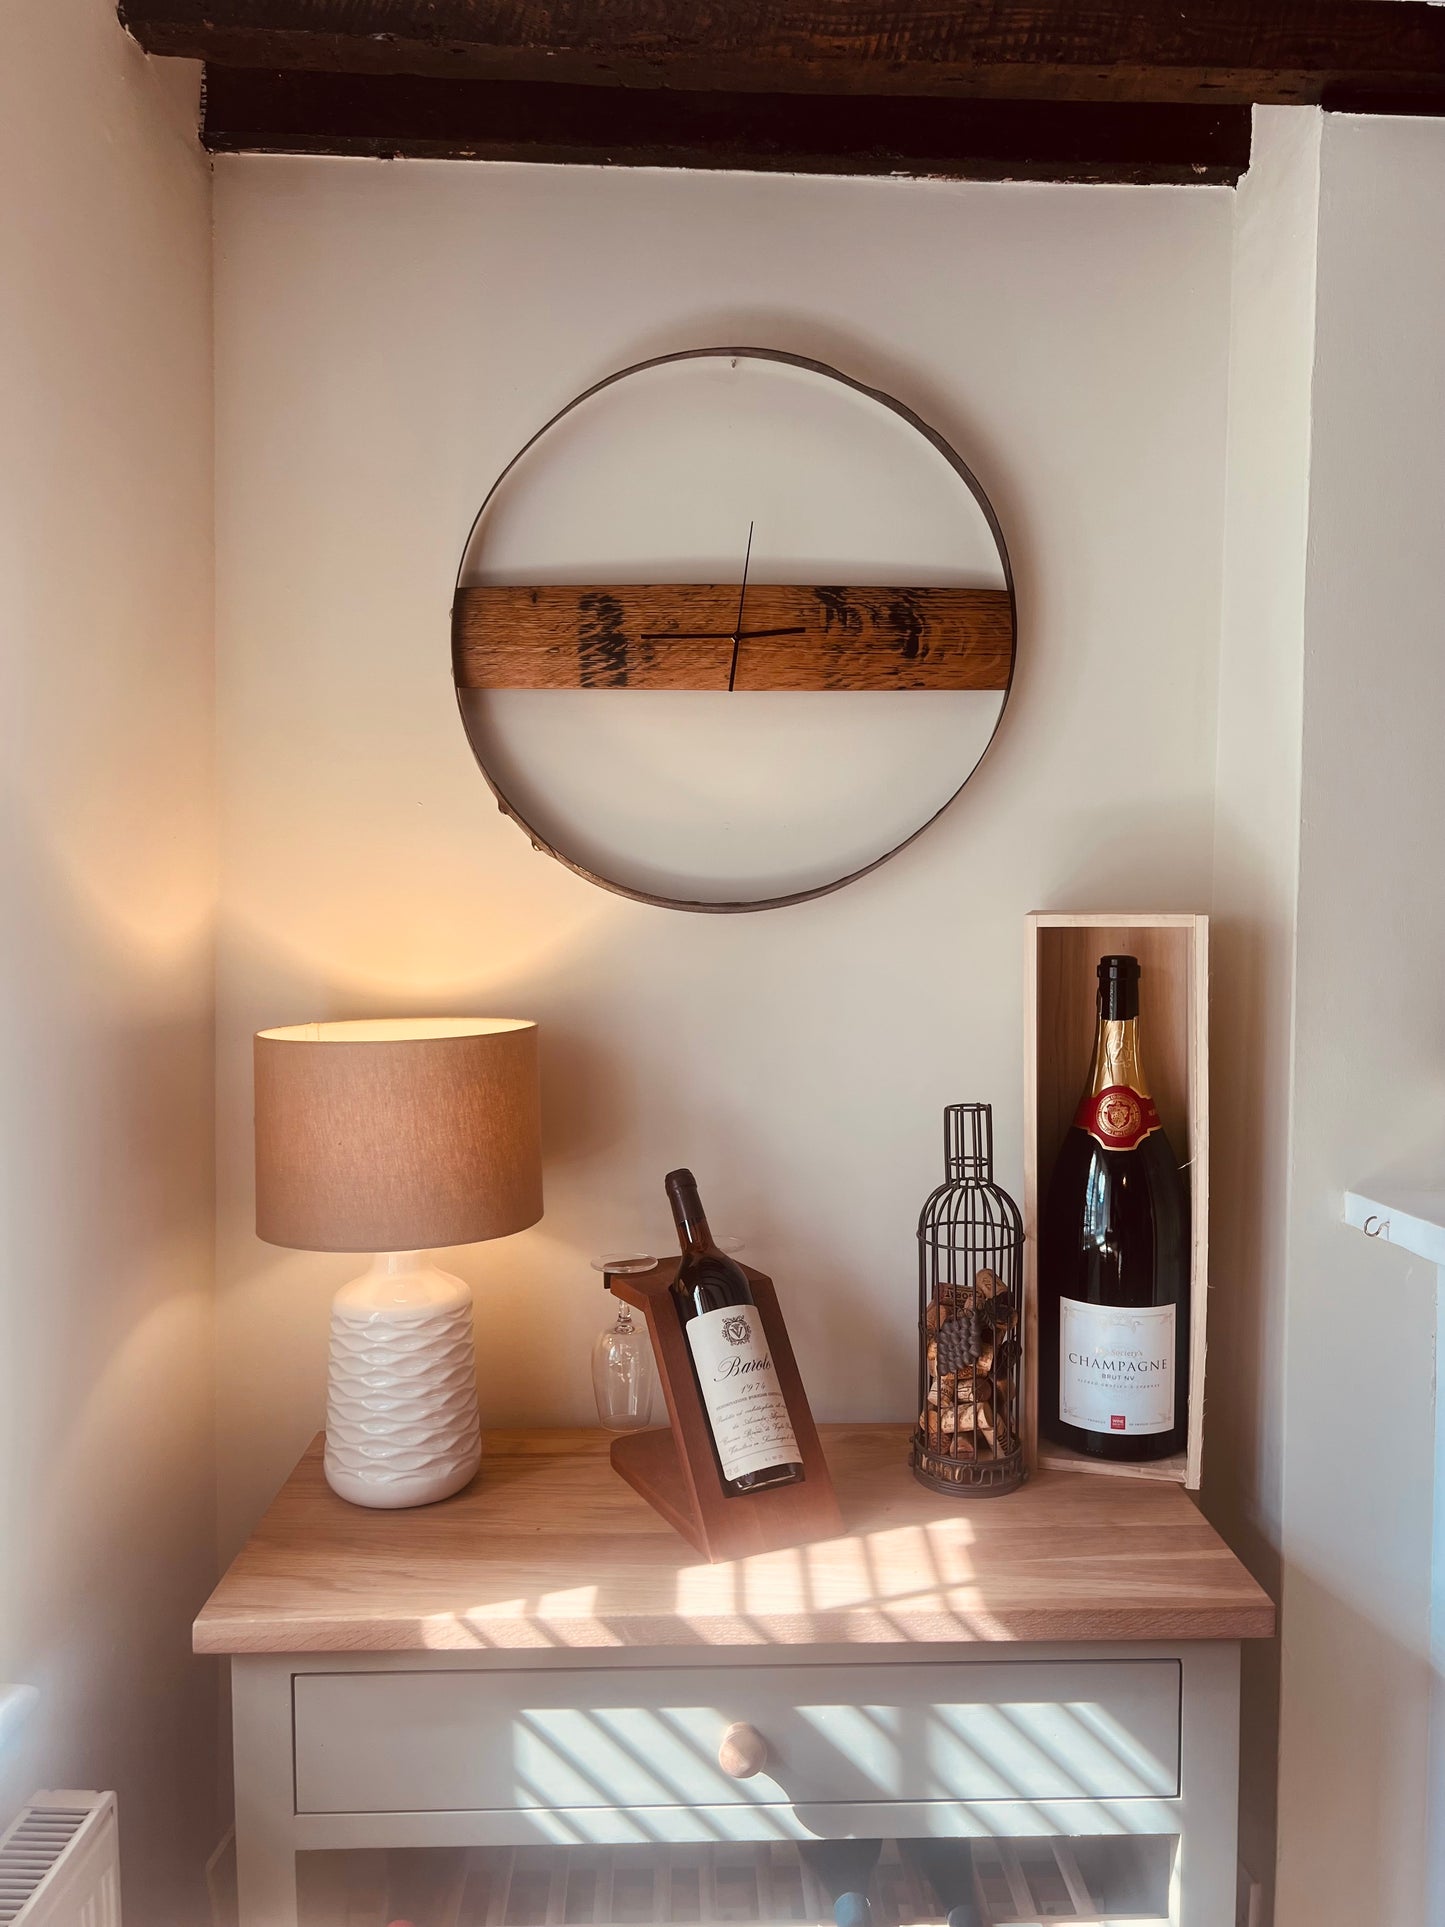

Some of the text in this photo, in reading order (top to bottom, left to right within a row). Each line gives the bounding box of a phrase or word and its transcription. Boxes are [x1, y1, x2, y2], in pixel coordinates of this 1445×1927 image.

[713, 1353, 771, 1382] Barolo
[1068, 1352, 1168, 1372] CHAMPAGNE
[1101, 1373, 1121, 1381] BRUT
